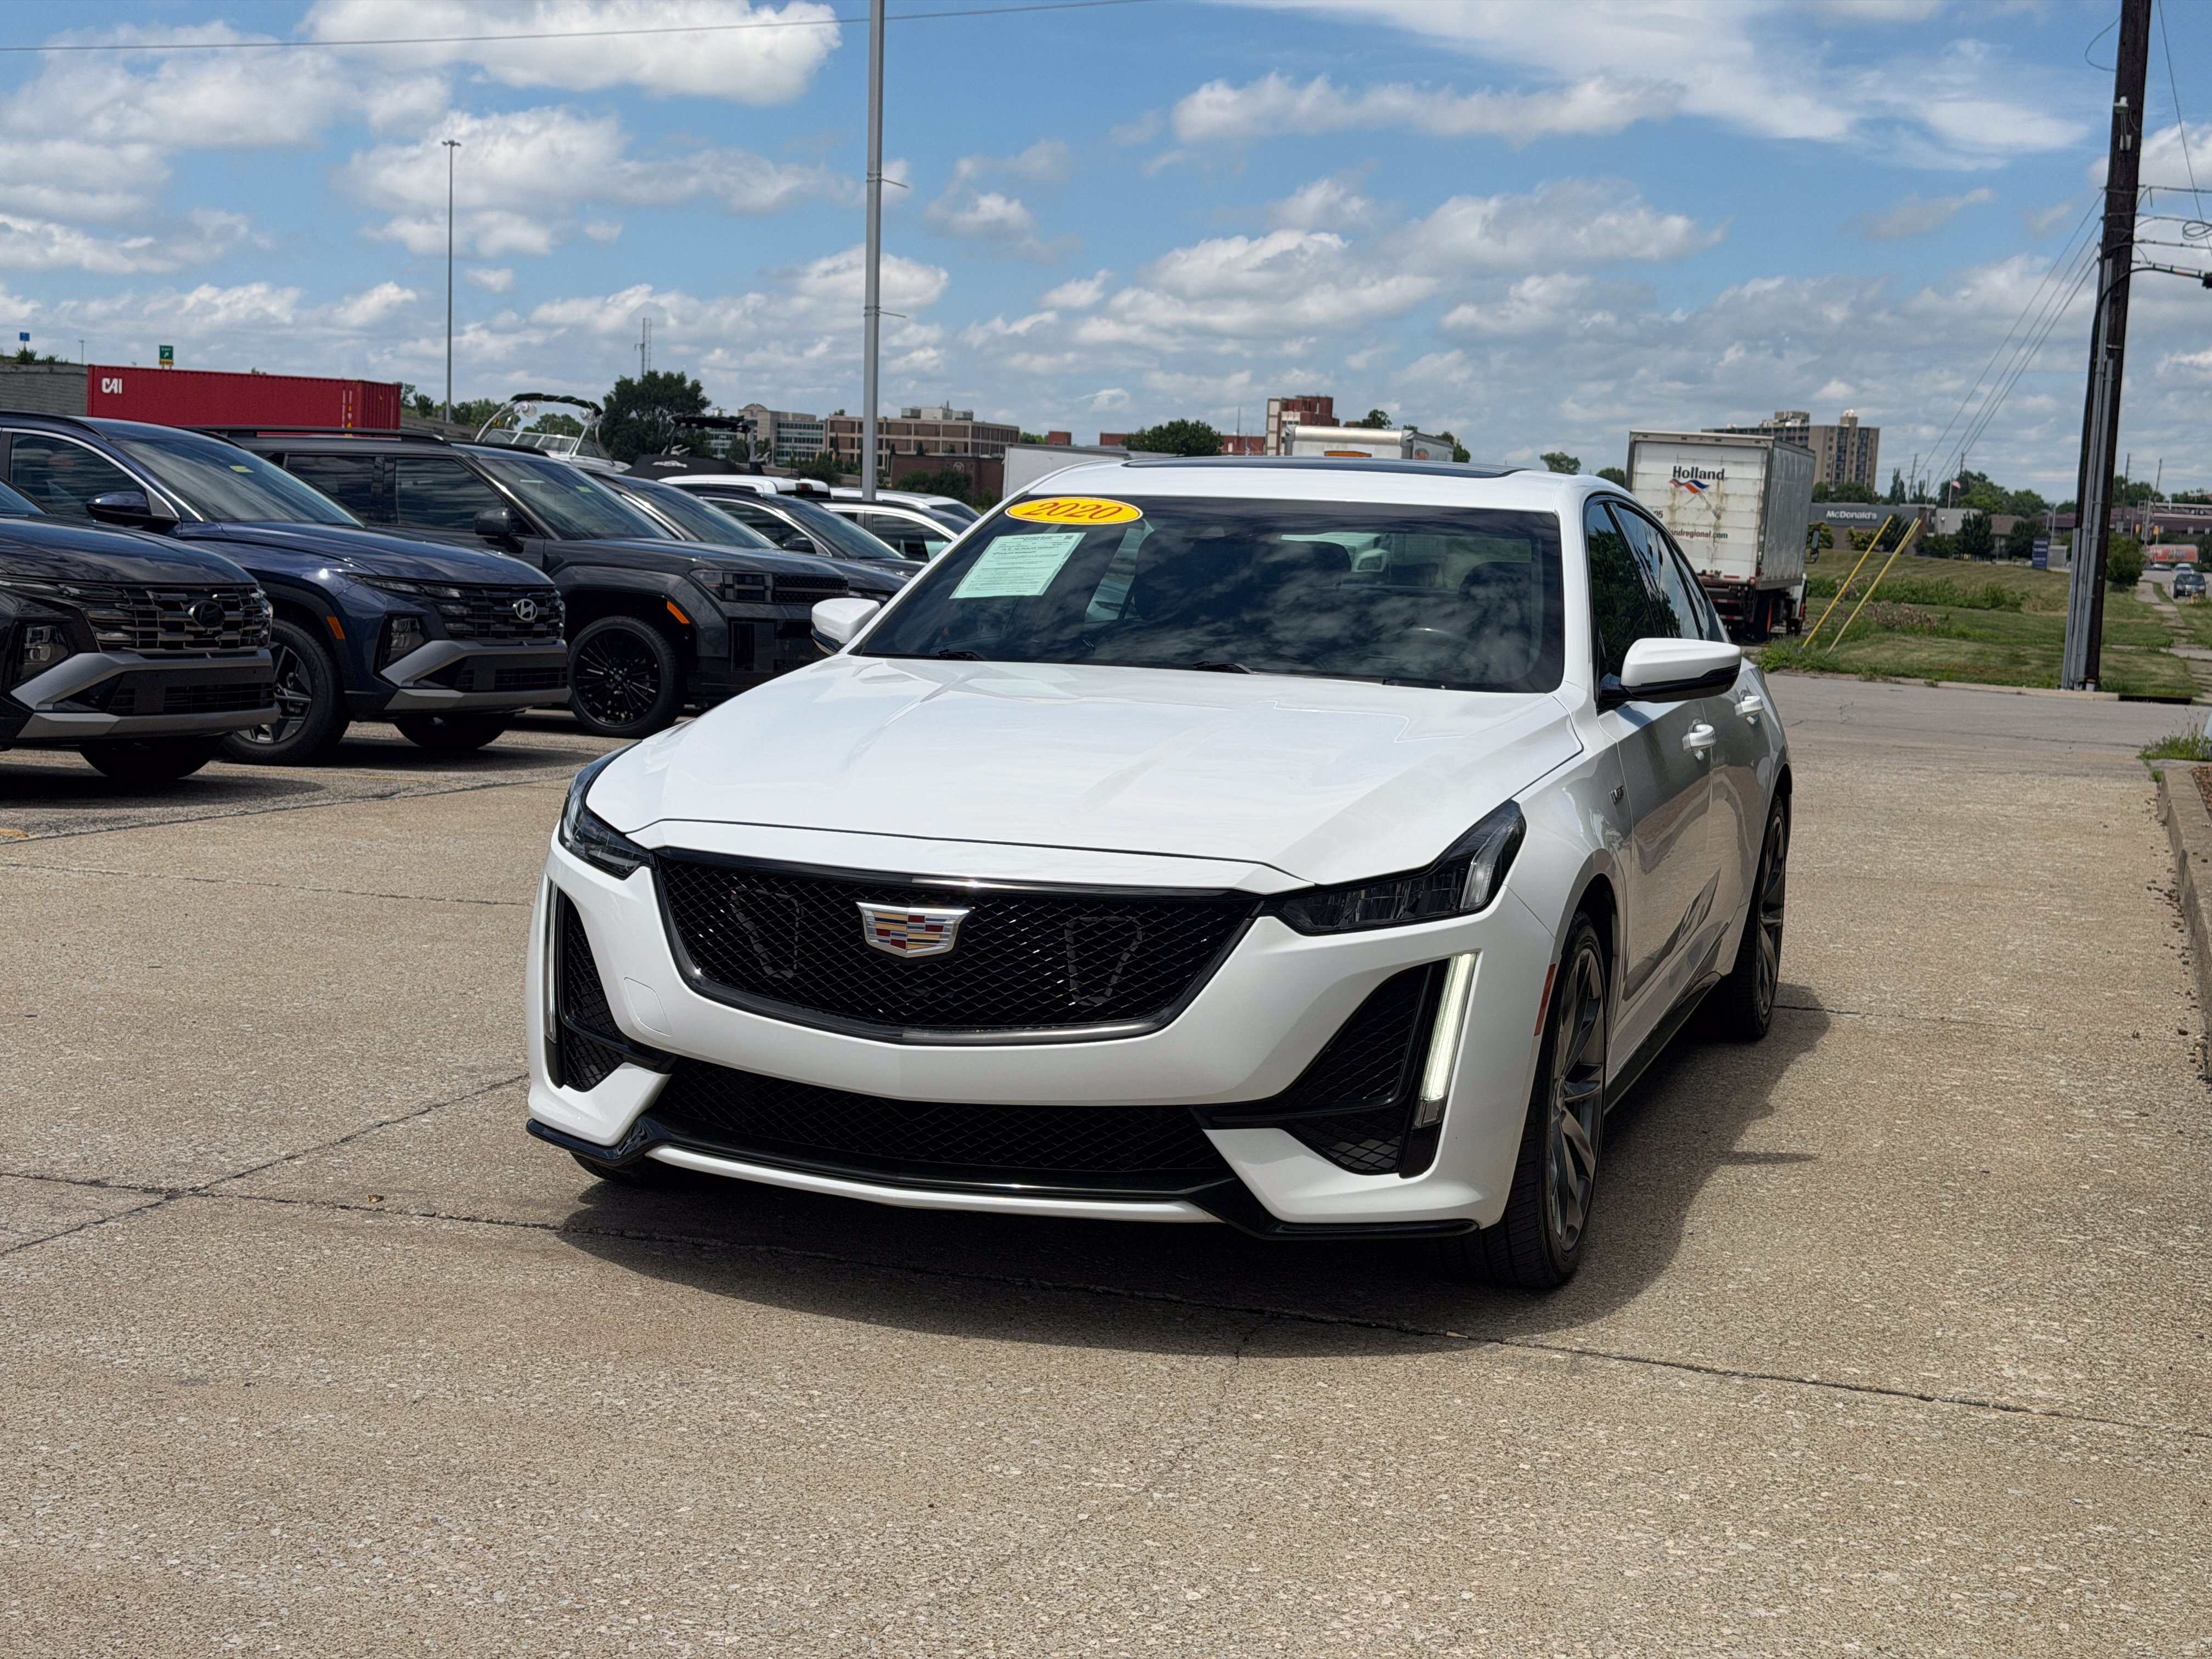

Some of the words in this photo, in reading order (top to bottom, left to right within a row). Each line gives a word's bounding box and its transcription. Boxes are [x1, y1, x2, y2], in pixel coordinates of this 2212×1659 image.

[101, 377, 122, 394] CAI
[1673, 466, 1725, 480] Holland
[1021, 502, 1123, 520] 2020
[1826, 510, 1877, 520] McDonald's
